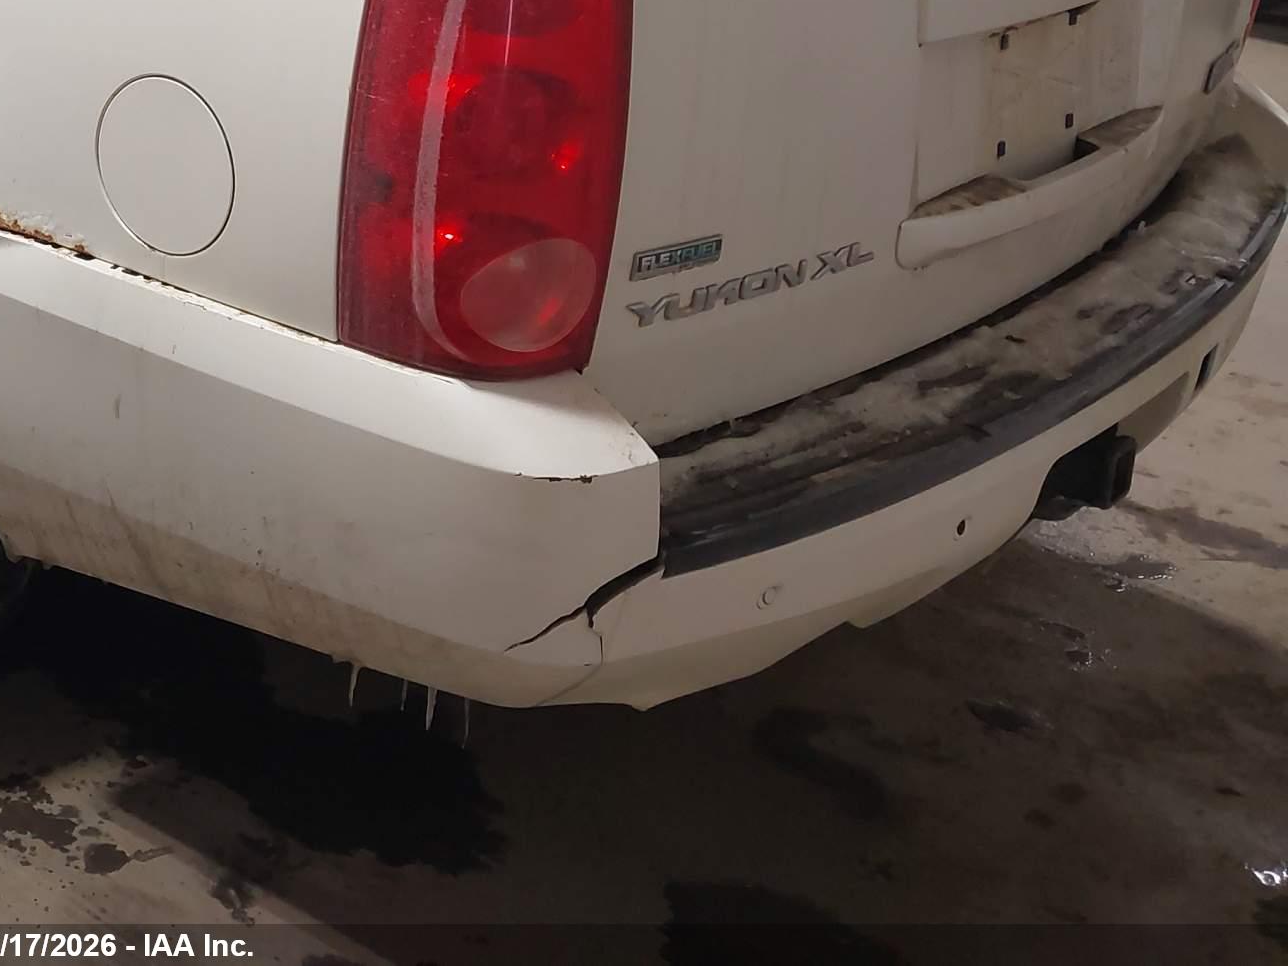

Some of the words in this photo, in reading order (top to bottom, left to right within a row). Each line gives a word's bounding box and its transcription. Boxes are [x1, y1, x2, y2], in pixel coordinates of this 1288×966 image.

[625, 258, 808, 328] YUKON
[810, 241, 875, 281] XL
[638, 240, 720, 273] FLEXFUEL
